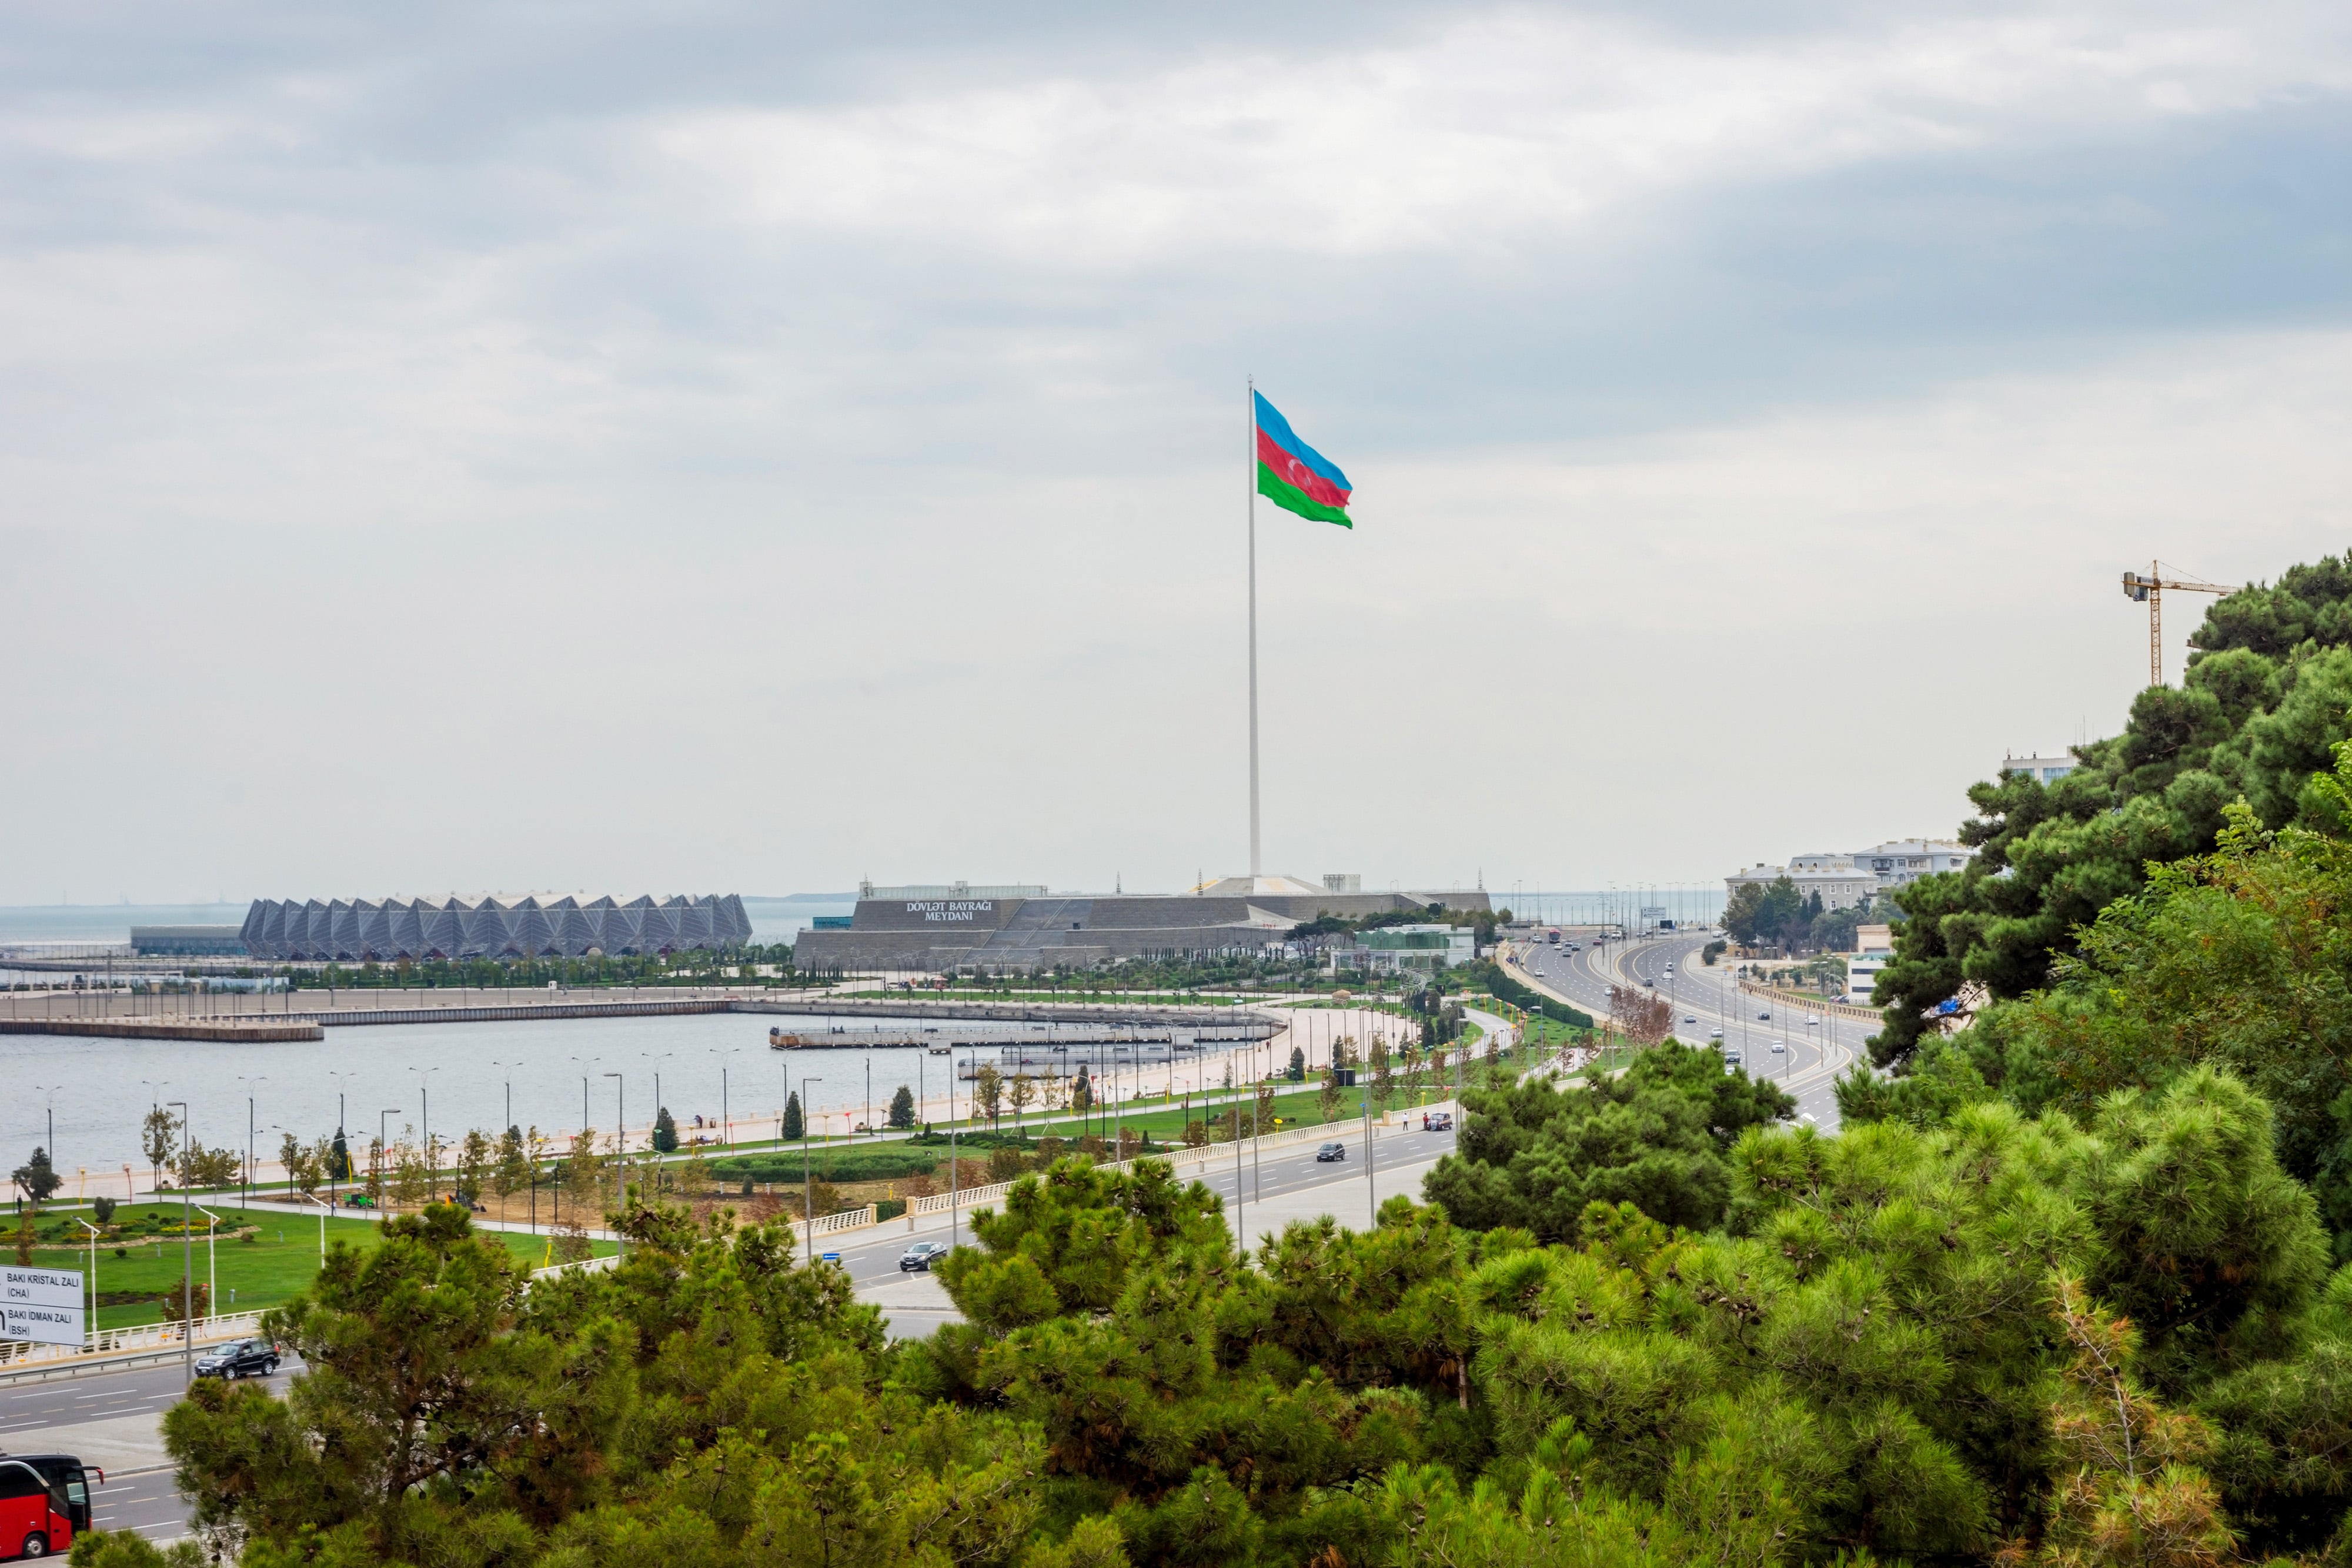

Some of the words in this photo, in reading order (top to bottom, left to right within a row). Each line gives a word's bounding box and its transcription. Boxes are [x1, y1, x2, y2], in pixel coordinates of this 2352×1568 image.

[907, 901, 946, 911] DÖVLƏT
[949, 900, 991, 911] BAYRAĞI
[925, 911, 973, 921] MEYDANI
[7, 1273, 25, 1283] BAKI
[28, 1273, 59, 1286] KRİSTAL
[61, 1277, 79, 1287] ZALI
[8, 1286, 29, 1299] (CHA)
[8, 1309, 26, 1320] BAKI
[28, 1309, 53, 1322] İDMAN
[55, 1313, 72, 1323] ZALI
[9, 1324, 30, 1336] (BSH)
